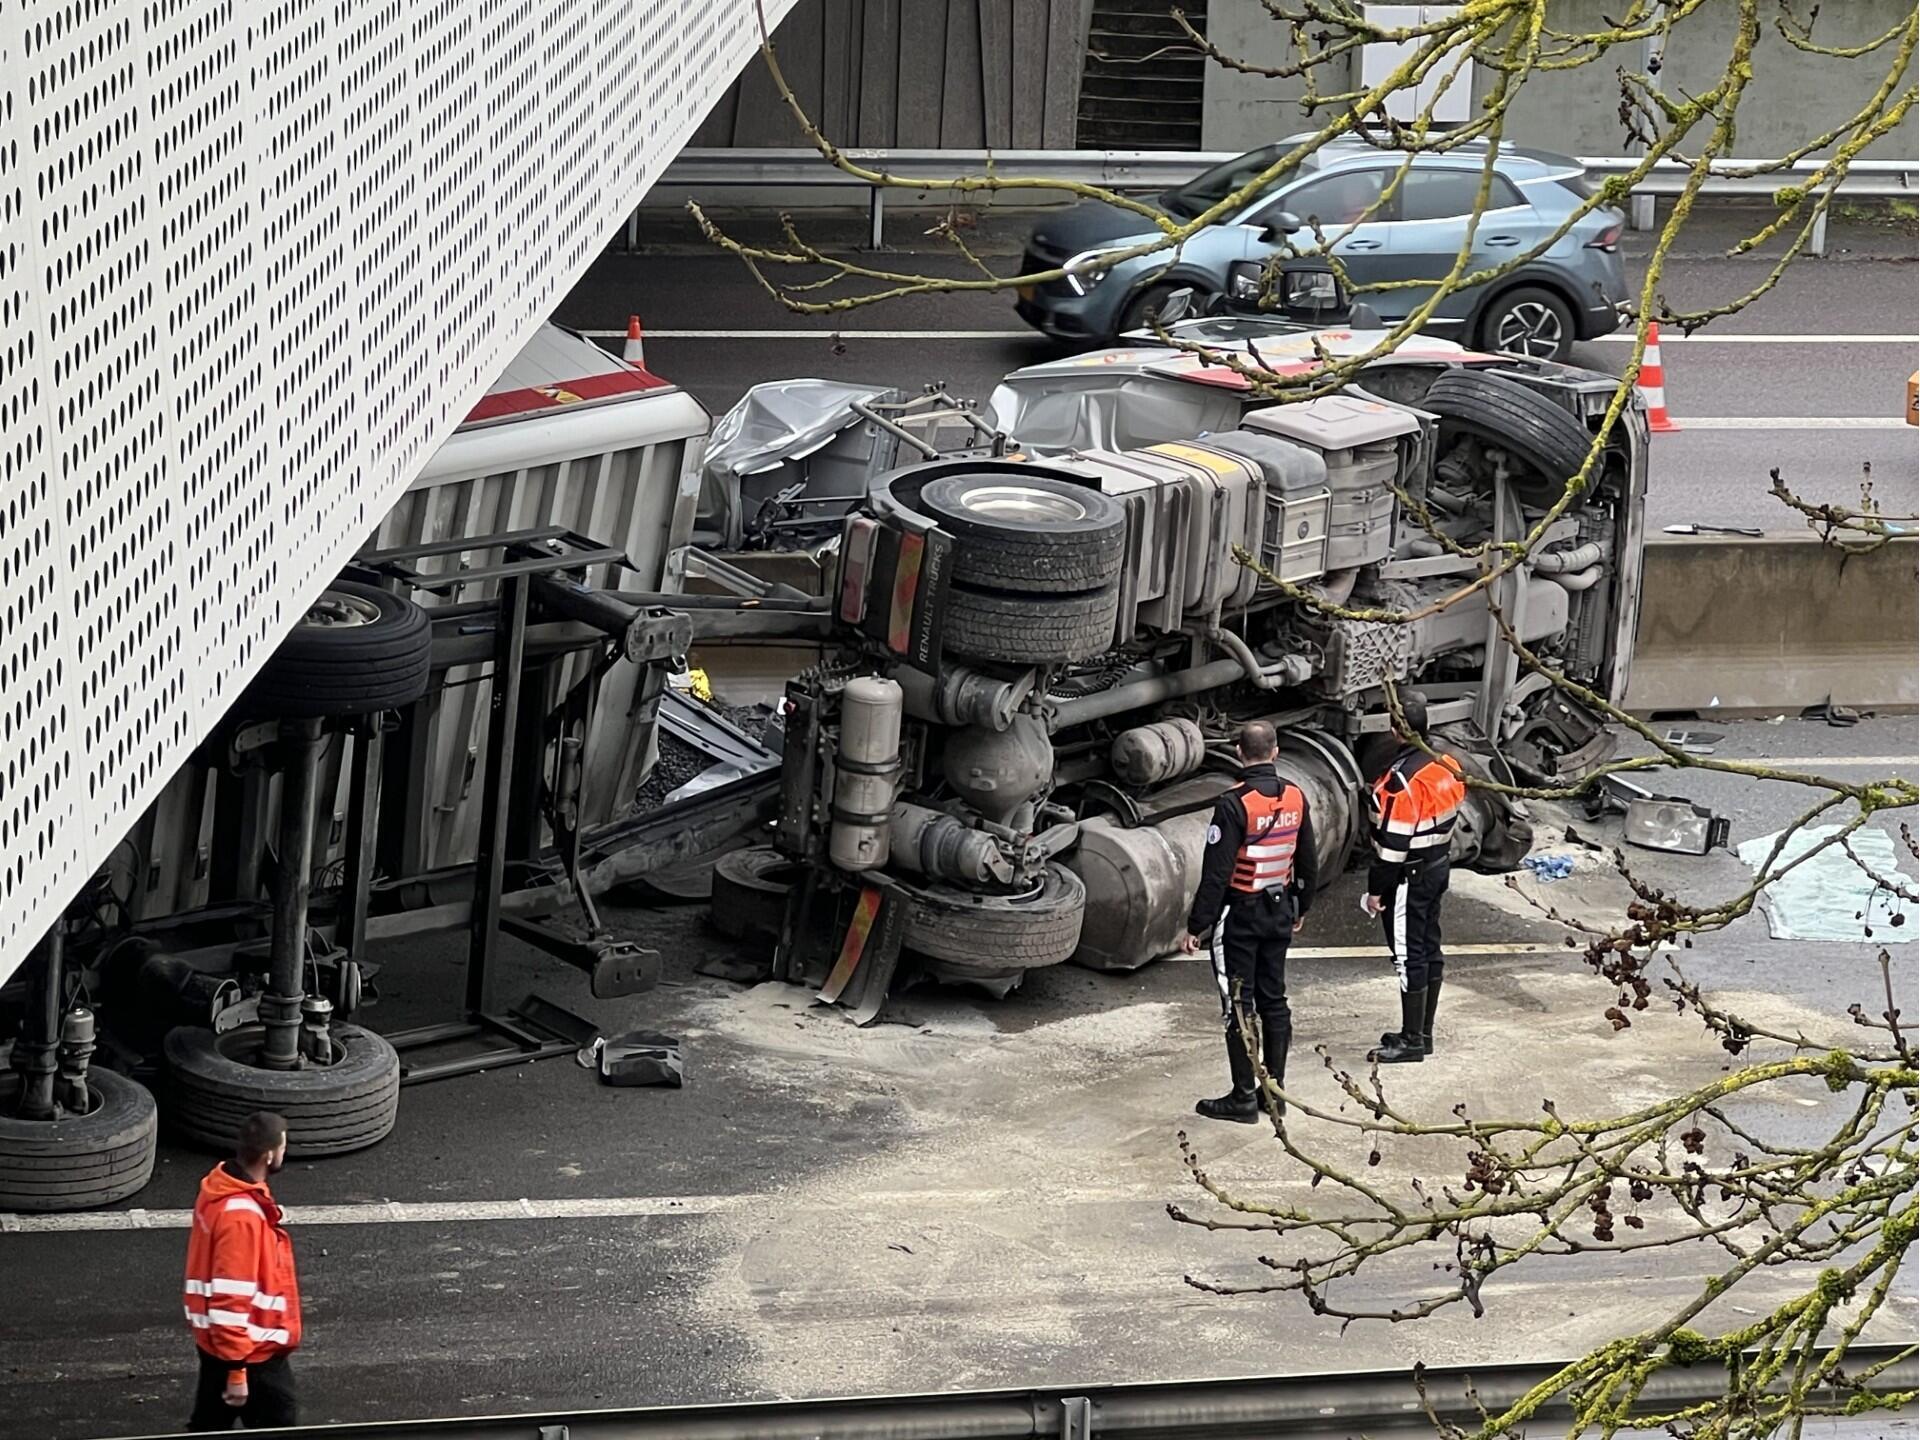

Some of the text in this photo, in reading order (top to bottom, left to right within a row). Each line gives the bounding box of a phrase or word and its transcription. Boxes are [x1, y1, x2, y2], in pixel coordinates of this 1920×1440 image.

[919, 543, 944, 663] RENAULT TRUCKS
[1256, 811, 1299, 831] POLICE
